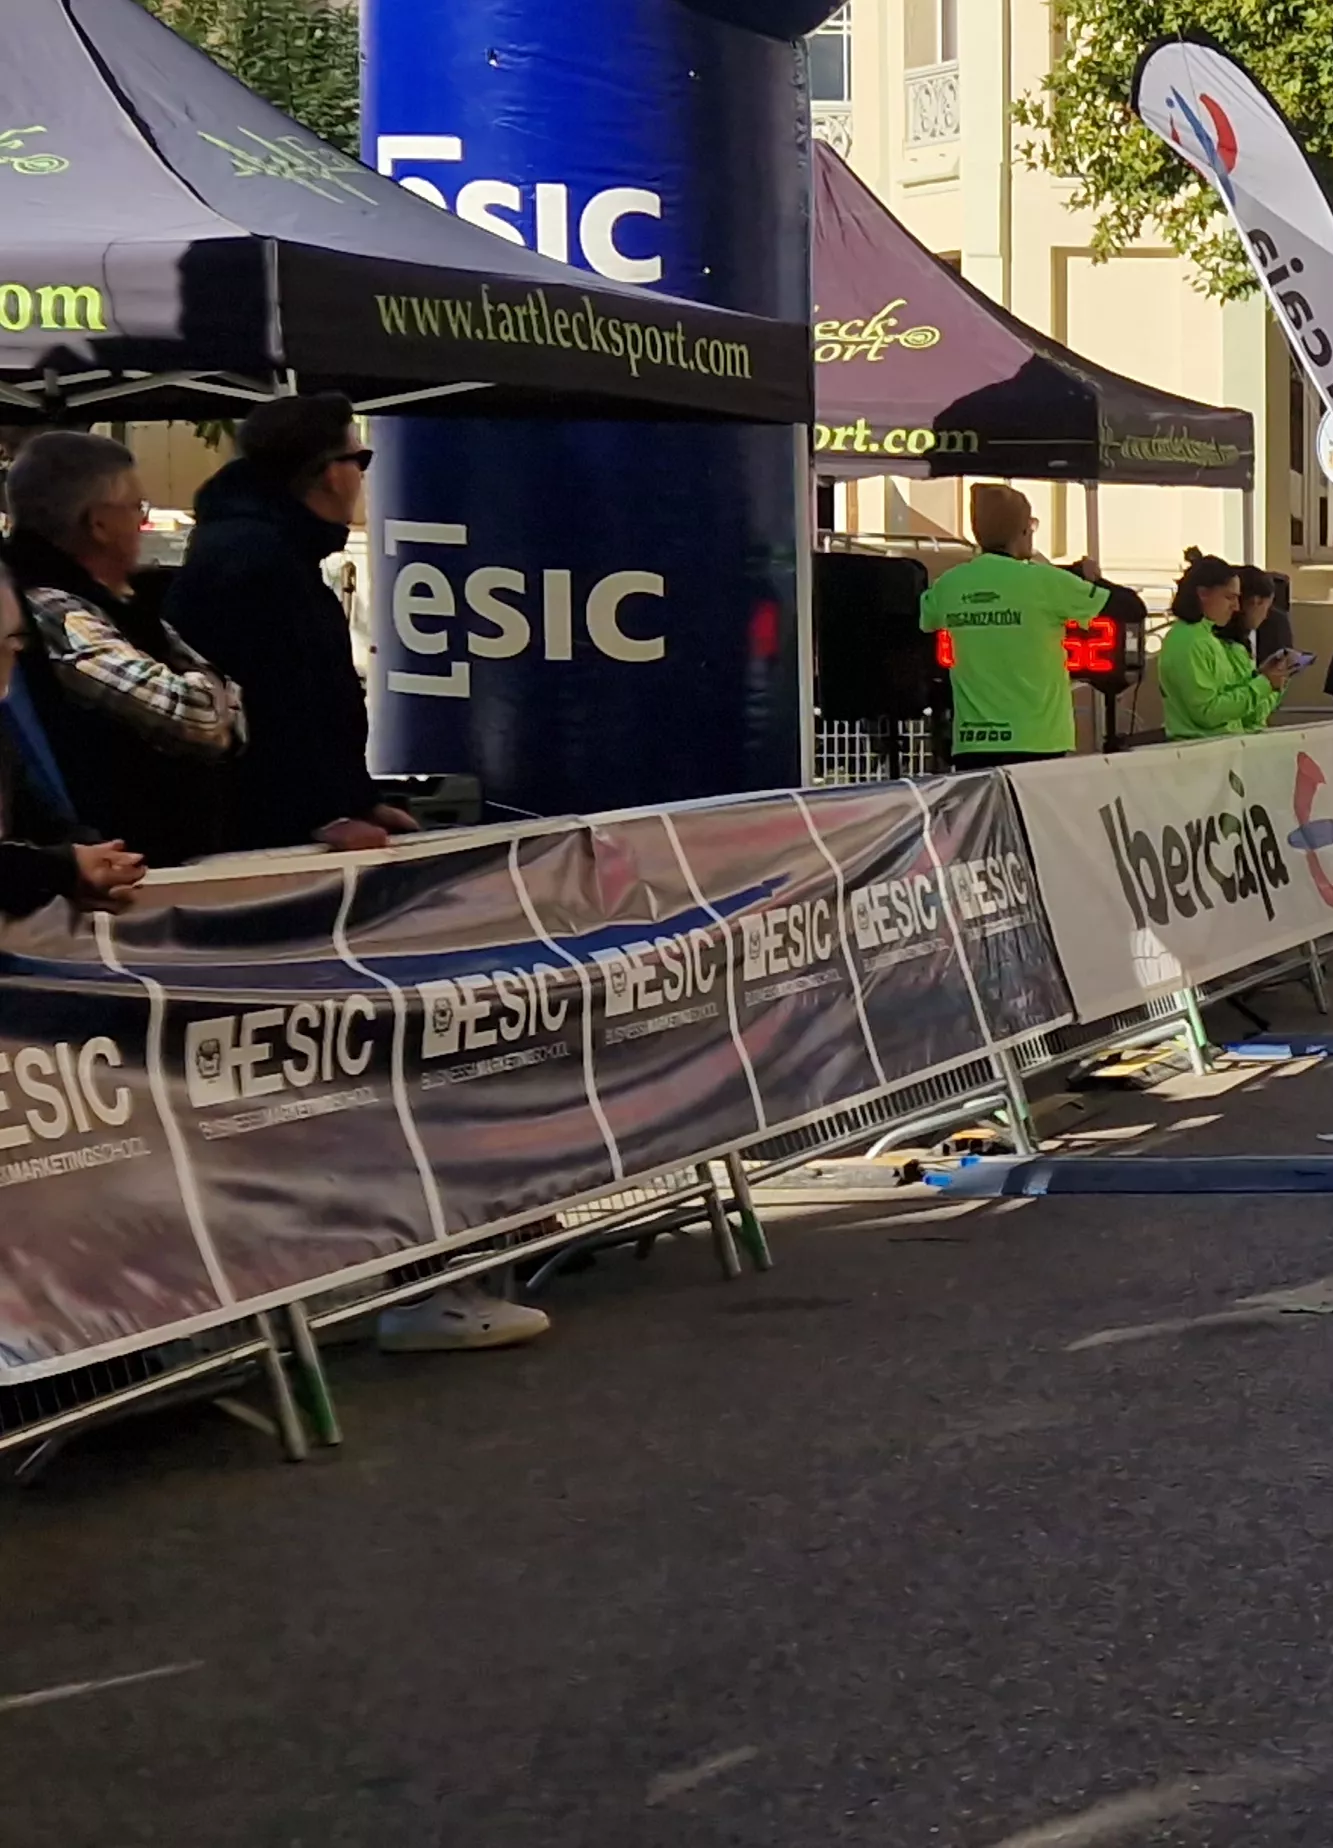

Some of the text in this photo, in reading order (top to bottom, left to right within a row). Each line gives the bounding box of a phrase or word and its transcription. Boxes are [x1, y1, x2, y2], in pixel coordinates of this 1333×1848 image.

[376, 283, 752, 381] www.fartlecksport.com
[1098, 769, 1290, 930] Ibercaja
[763, 898, 831, 975] ESIC
[871, 874, 938, 947] ESIC
[454, 963, 568, 1050] ESIC
[622, 928, 717, 1010] ESIC
[240, 994, 376, 1097] ESIC
